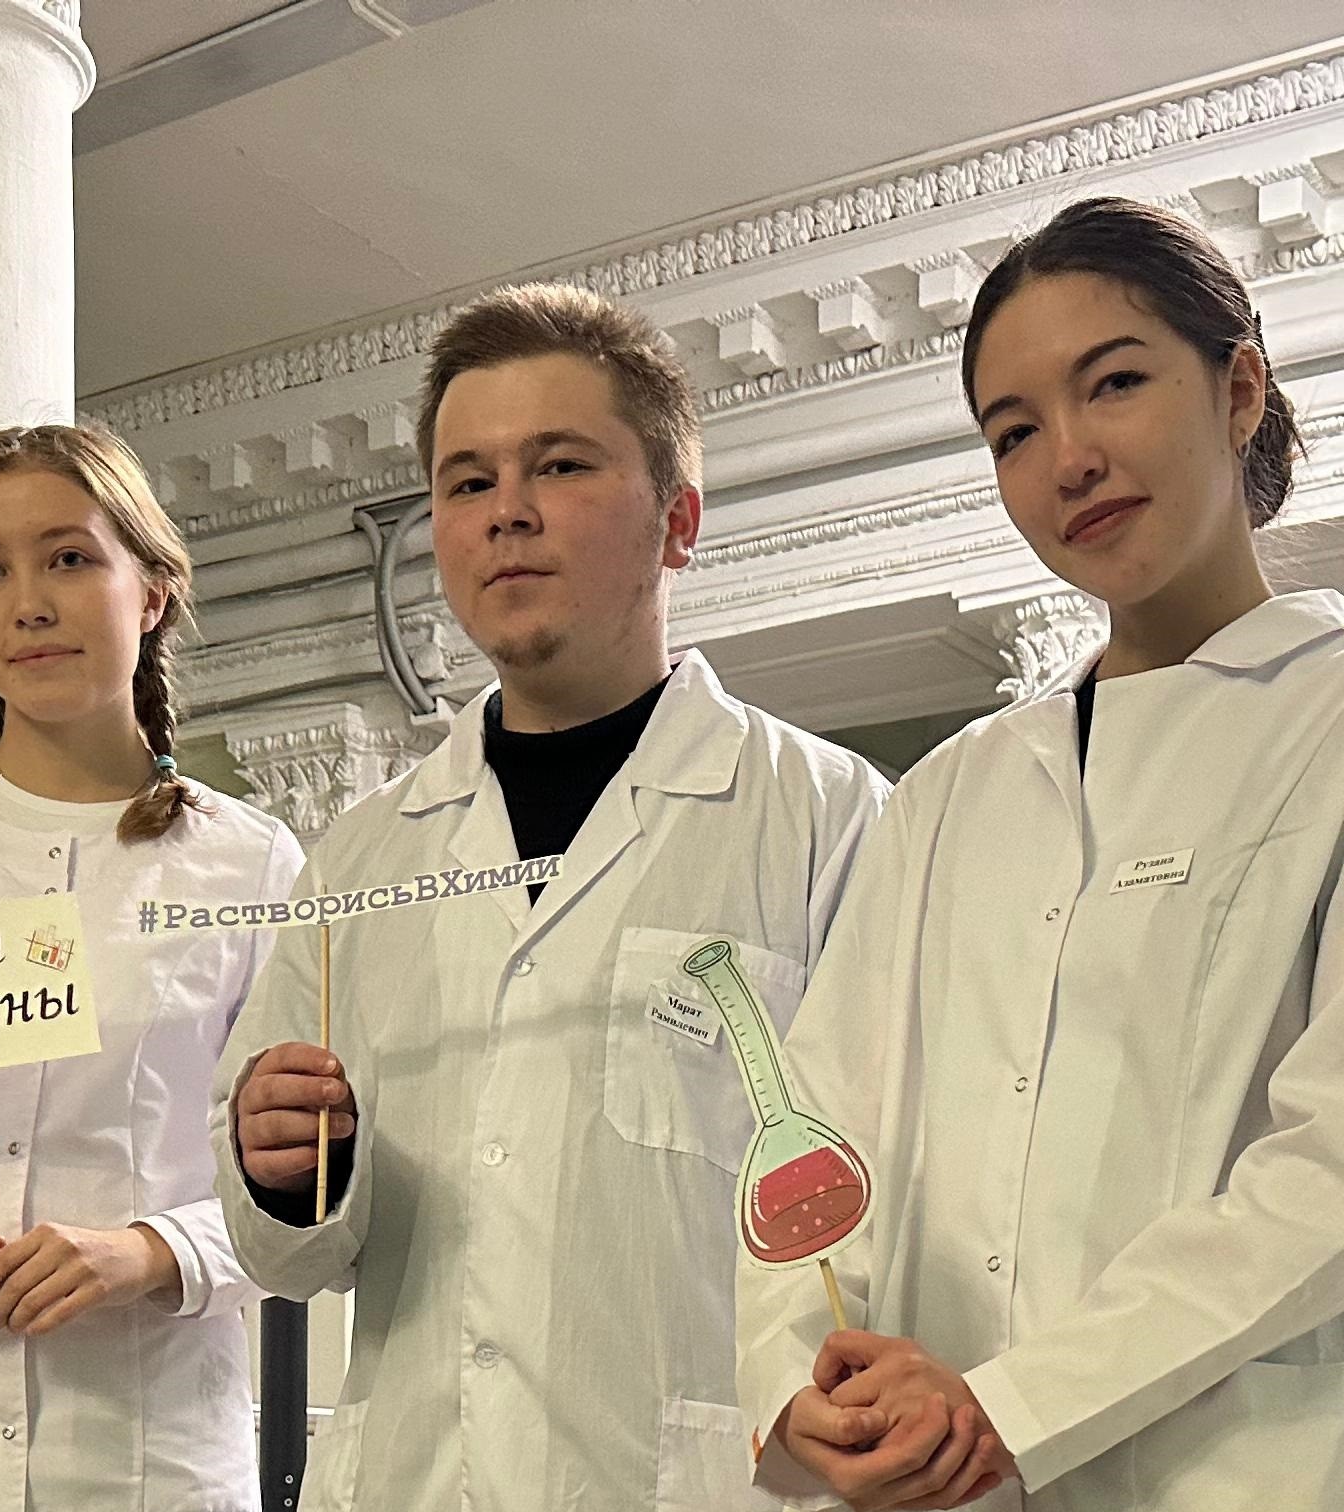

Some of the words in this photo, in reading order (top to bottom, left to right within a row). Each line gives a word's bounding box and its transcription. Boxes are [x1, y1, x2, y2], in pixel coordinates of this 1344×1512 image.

[138, 857, 561, 933] #РастворисьВХимии
[651, 1007, 709, 1039] Рамилевич
[668, 996, 702, 1018] Марат
